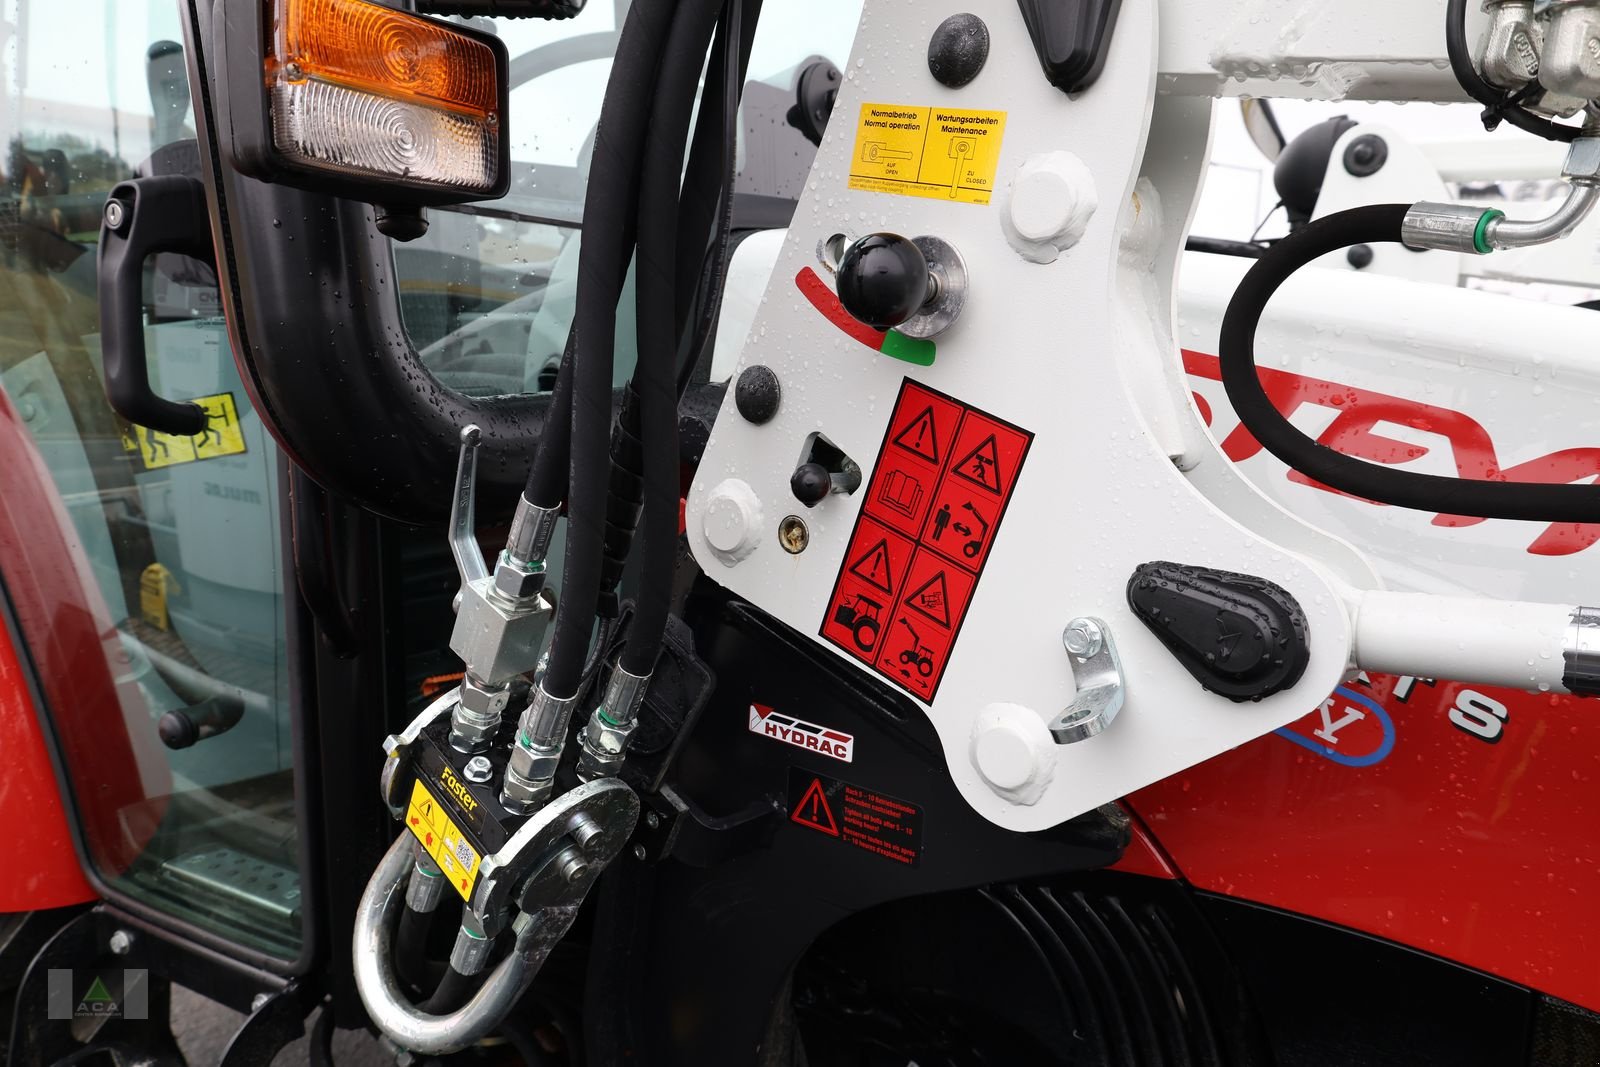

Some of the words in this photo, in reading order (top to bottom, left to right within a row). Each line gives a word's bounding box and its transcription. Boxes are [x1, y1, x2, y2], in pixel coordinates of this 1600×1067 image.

[871, 109, 918, 120] Normalbetrieb
[936, 113, 999, 126] Wartungsarbeiten
[864, 119, 888, 129] Normal
[888, 121, 920, 131] operation
[941, 125, 988, 136] Maintenance
[885, 168, 899, 176] OPEN
[965, 177, 987, 185] CLOSED
[1448, 688, 1508, 744] S
[764, 721, 848, 759] HYDRAC
[441, 766, 478, 812] Faster
